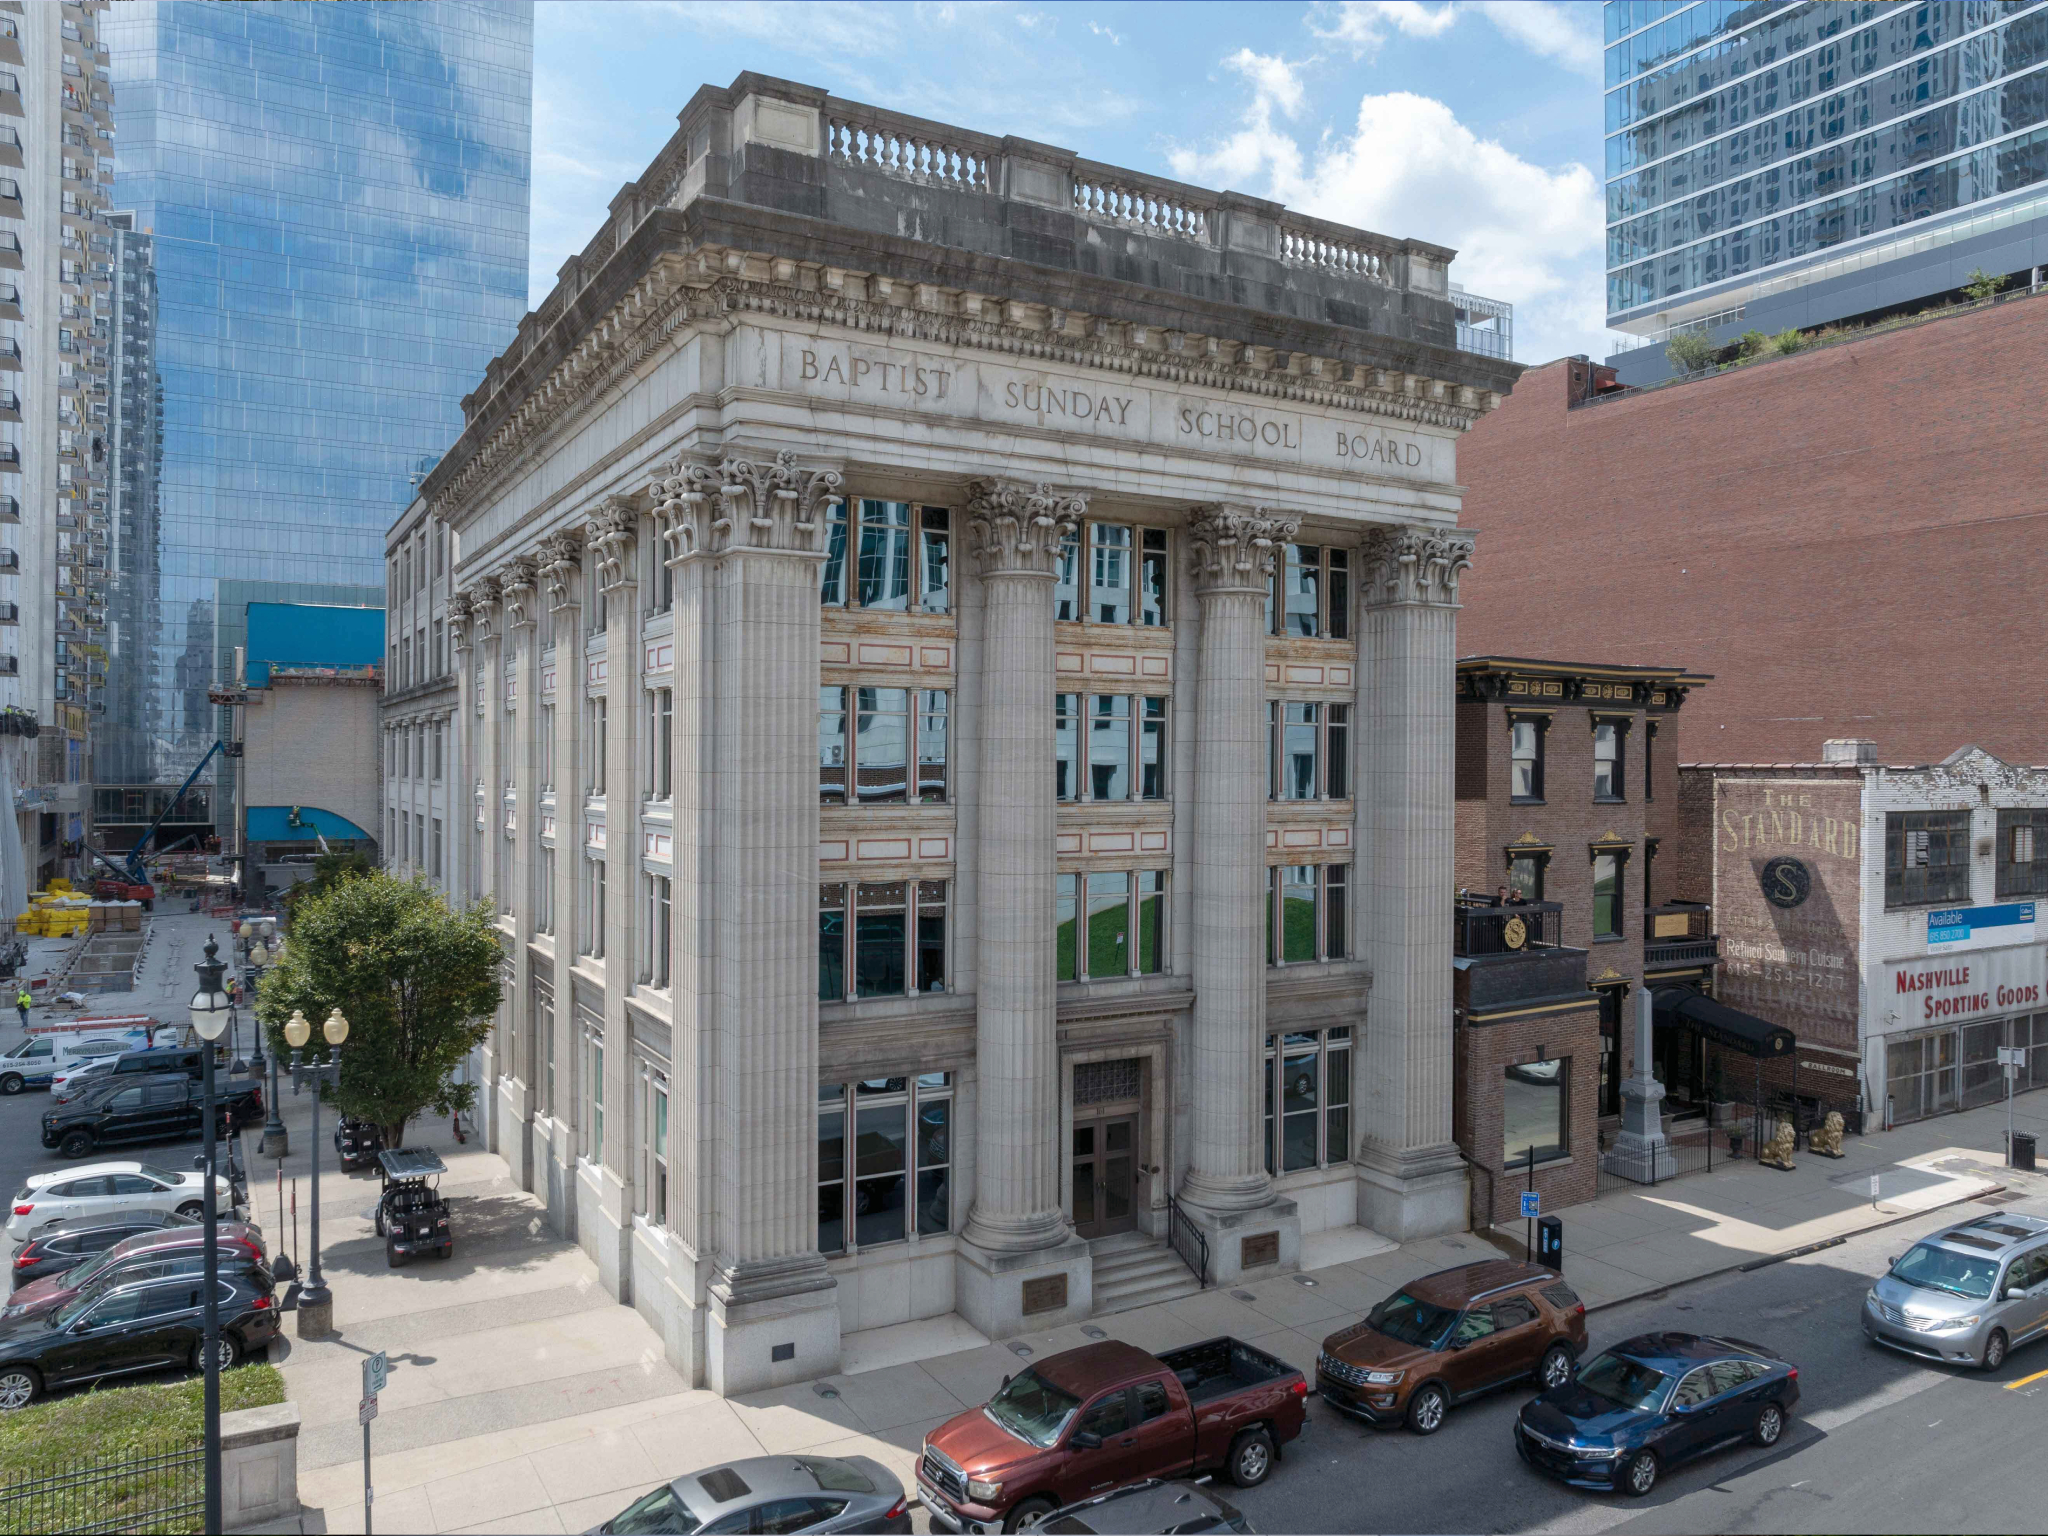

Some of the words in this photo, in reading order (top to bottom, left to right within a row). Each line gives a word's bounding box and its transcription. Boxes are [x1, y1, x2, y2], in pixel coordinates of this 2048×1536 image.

[800, 349, 951, 399] BAPTIST
[1005, 381, 1134, 426] SUNDAY
[1180, 408, 1297, 449] SCHOOL
[1336, 432, 1421, 467] BOARD
[1763, 789, 1812, 807] THE
[1722, 809, 1857, 859] STANDARD
[1774, 864, 1797, 900] S
[1929, 910, 1963, 926] Available
[1726, 938, 1762, 960] Refined
[1764, 943, 1807, 966] Southern
[1809, 948, 1845, 969] Cuisine
[1726, 962, 1845, 991] 615-254-1277
[1896, 966, 1970, 995] NASHVILLE
[1924, 992, 1989, 1019] SPORTING
[1996, 984, 2039, 1007] GOODS
[1807, 1062, 1846, 1075] BALLROOM
